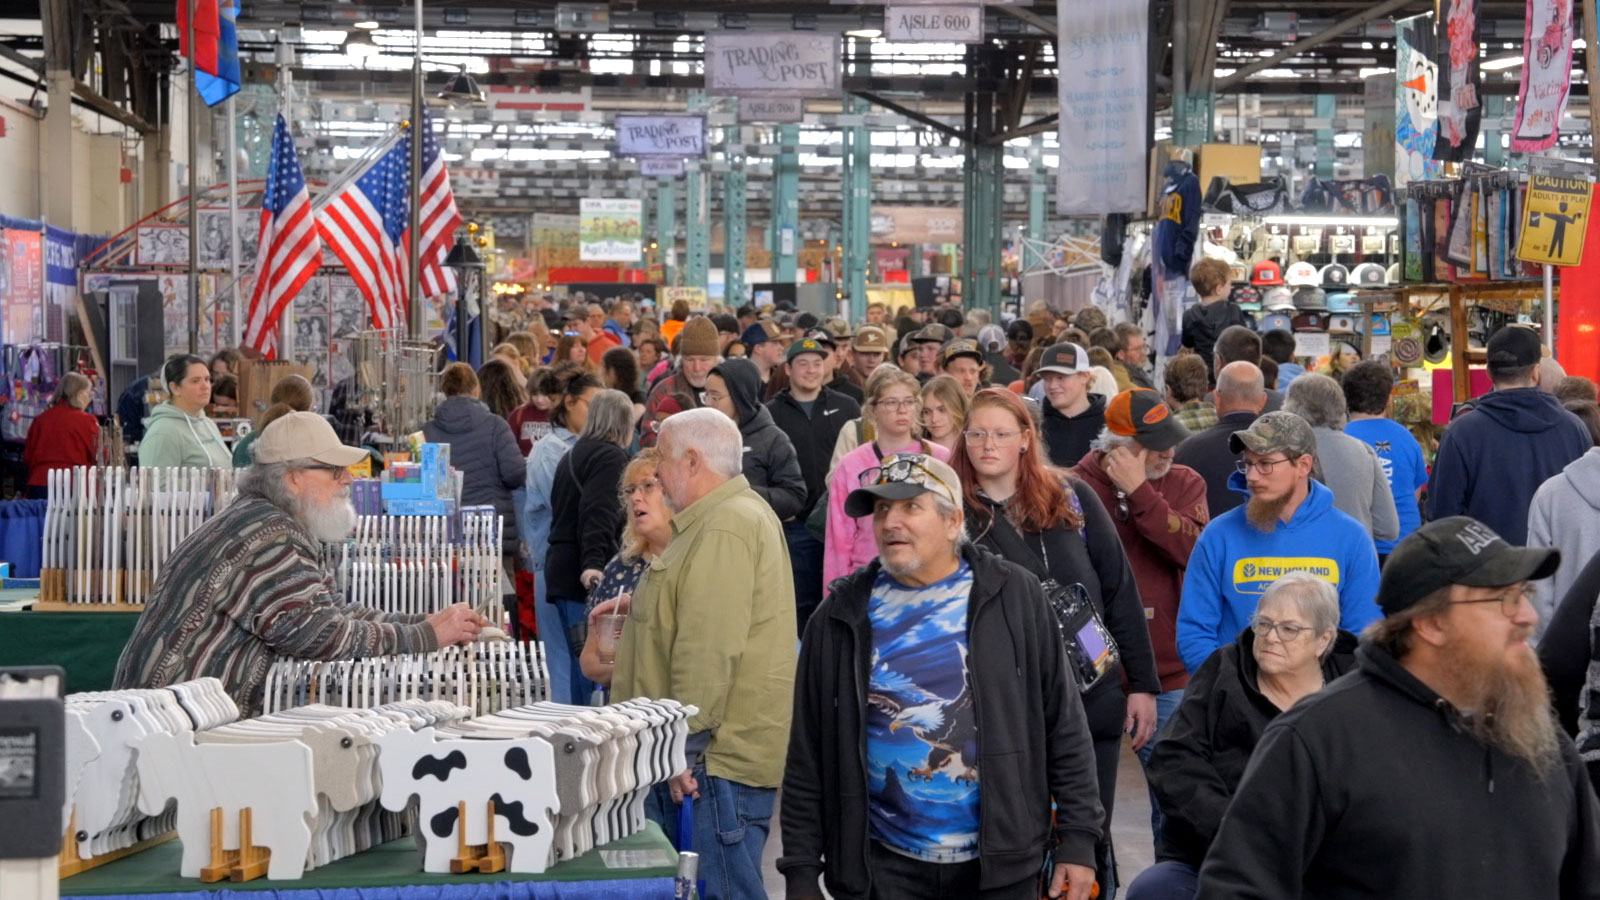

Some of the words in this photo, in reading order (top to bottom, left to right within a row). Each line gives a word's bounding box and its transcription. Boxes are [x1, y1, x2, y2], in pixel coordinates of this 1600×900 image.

[899, 14, 940, 31] AISLE
[943, 15, 971, 30] 600
[722, 42, 800, 76] TRADING
[780, 61, 828, 85] POST
[747, 104, 775, 115] AISLE
[626, 122, 680, 144] TRADING
[665, 135, 699, 151] POST
[1535, 175, 1587, 190] CAUTION
[1532, 191, 1559, 201] ADULTS
[1571, 195, 1586, 203] PLAY
[1258, 567, 1282, 576] NEW
